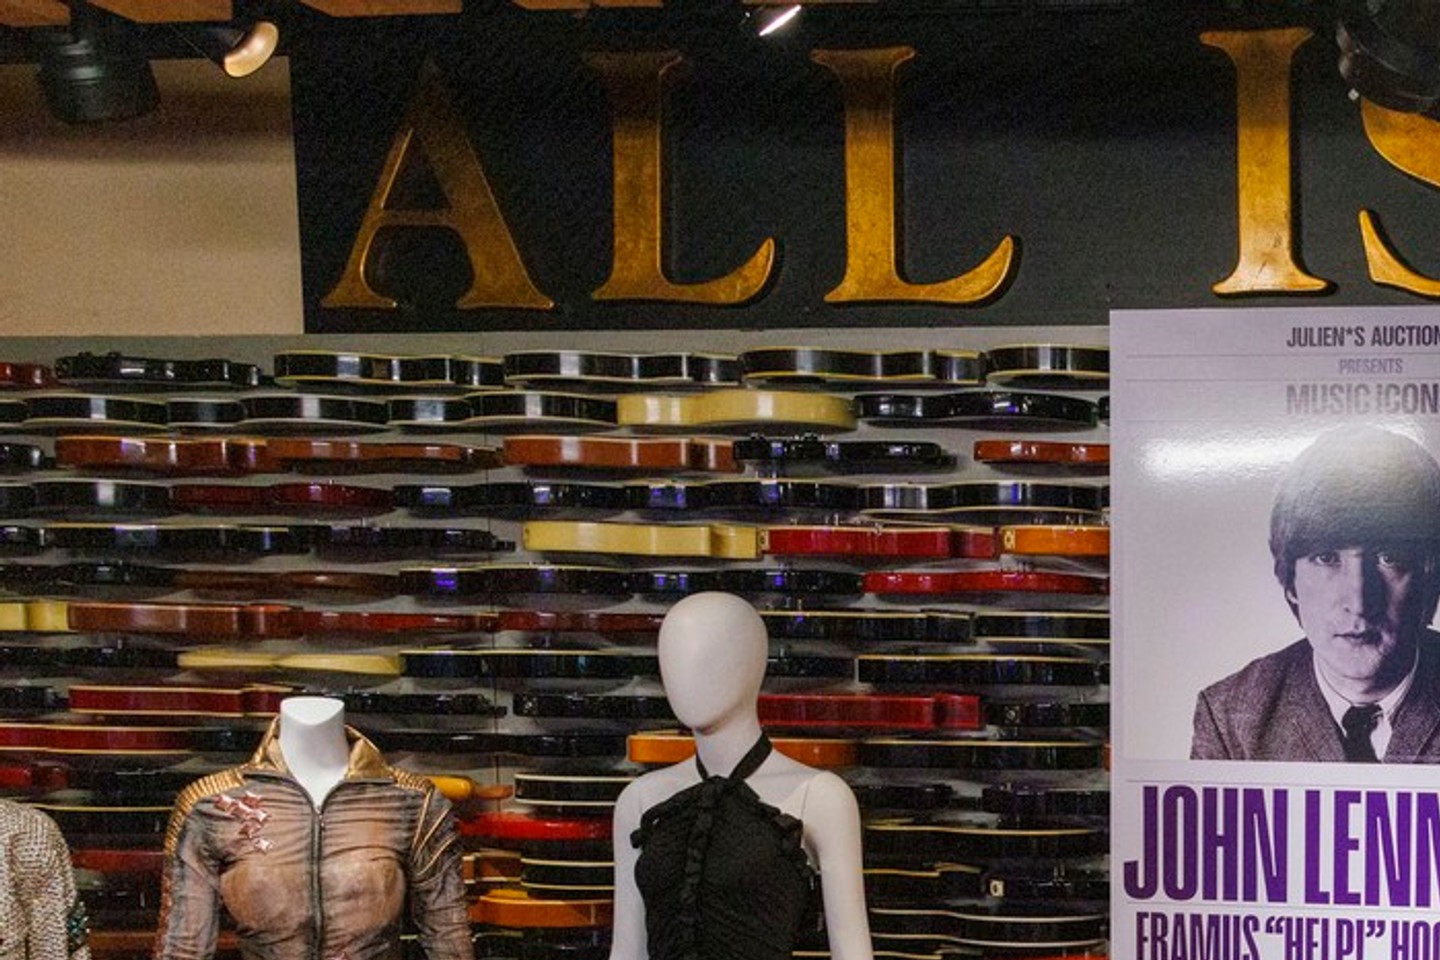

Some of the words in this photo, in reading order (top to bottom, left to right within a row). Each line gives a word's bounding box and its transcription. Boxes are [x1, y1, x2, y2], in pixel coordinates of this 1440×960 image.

[320, 45, 1018, 311] ALL
[1286, 383, 1372, 415] MUSIC
[1338, 358, 1403, 374] PRESENTS
[1123, 784, 1288, 902] JOHN
